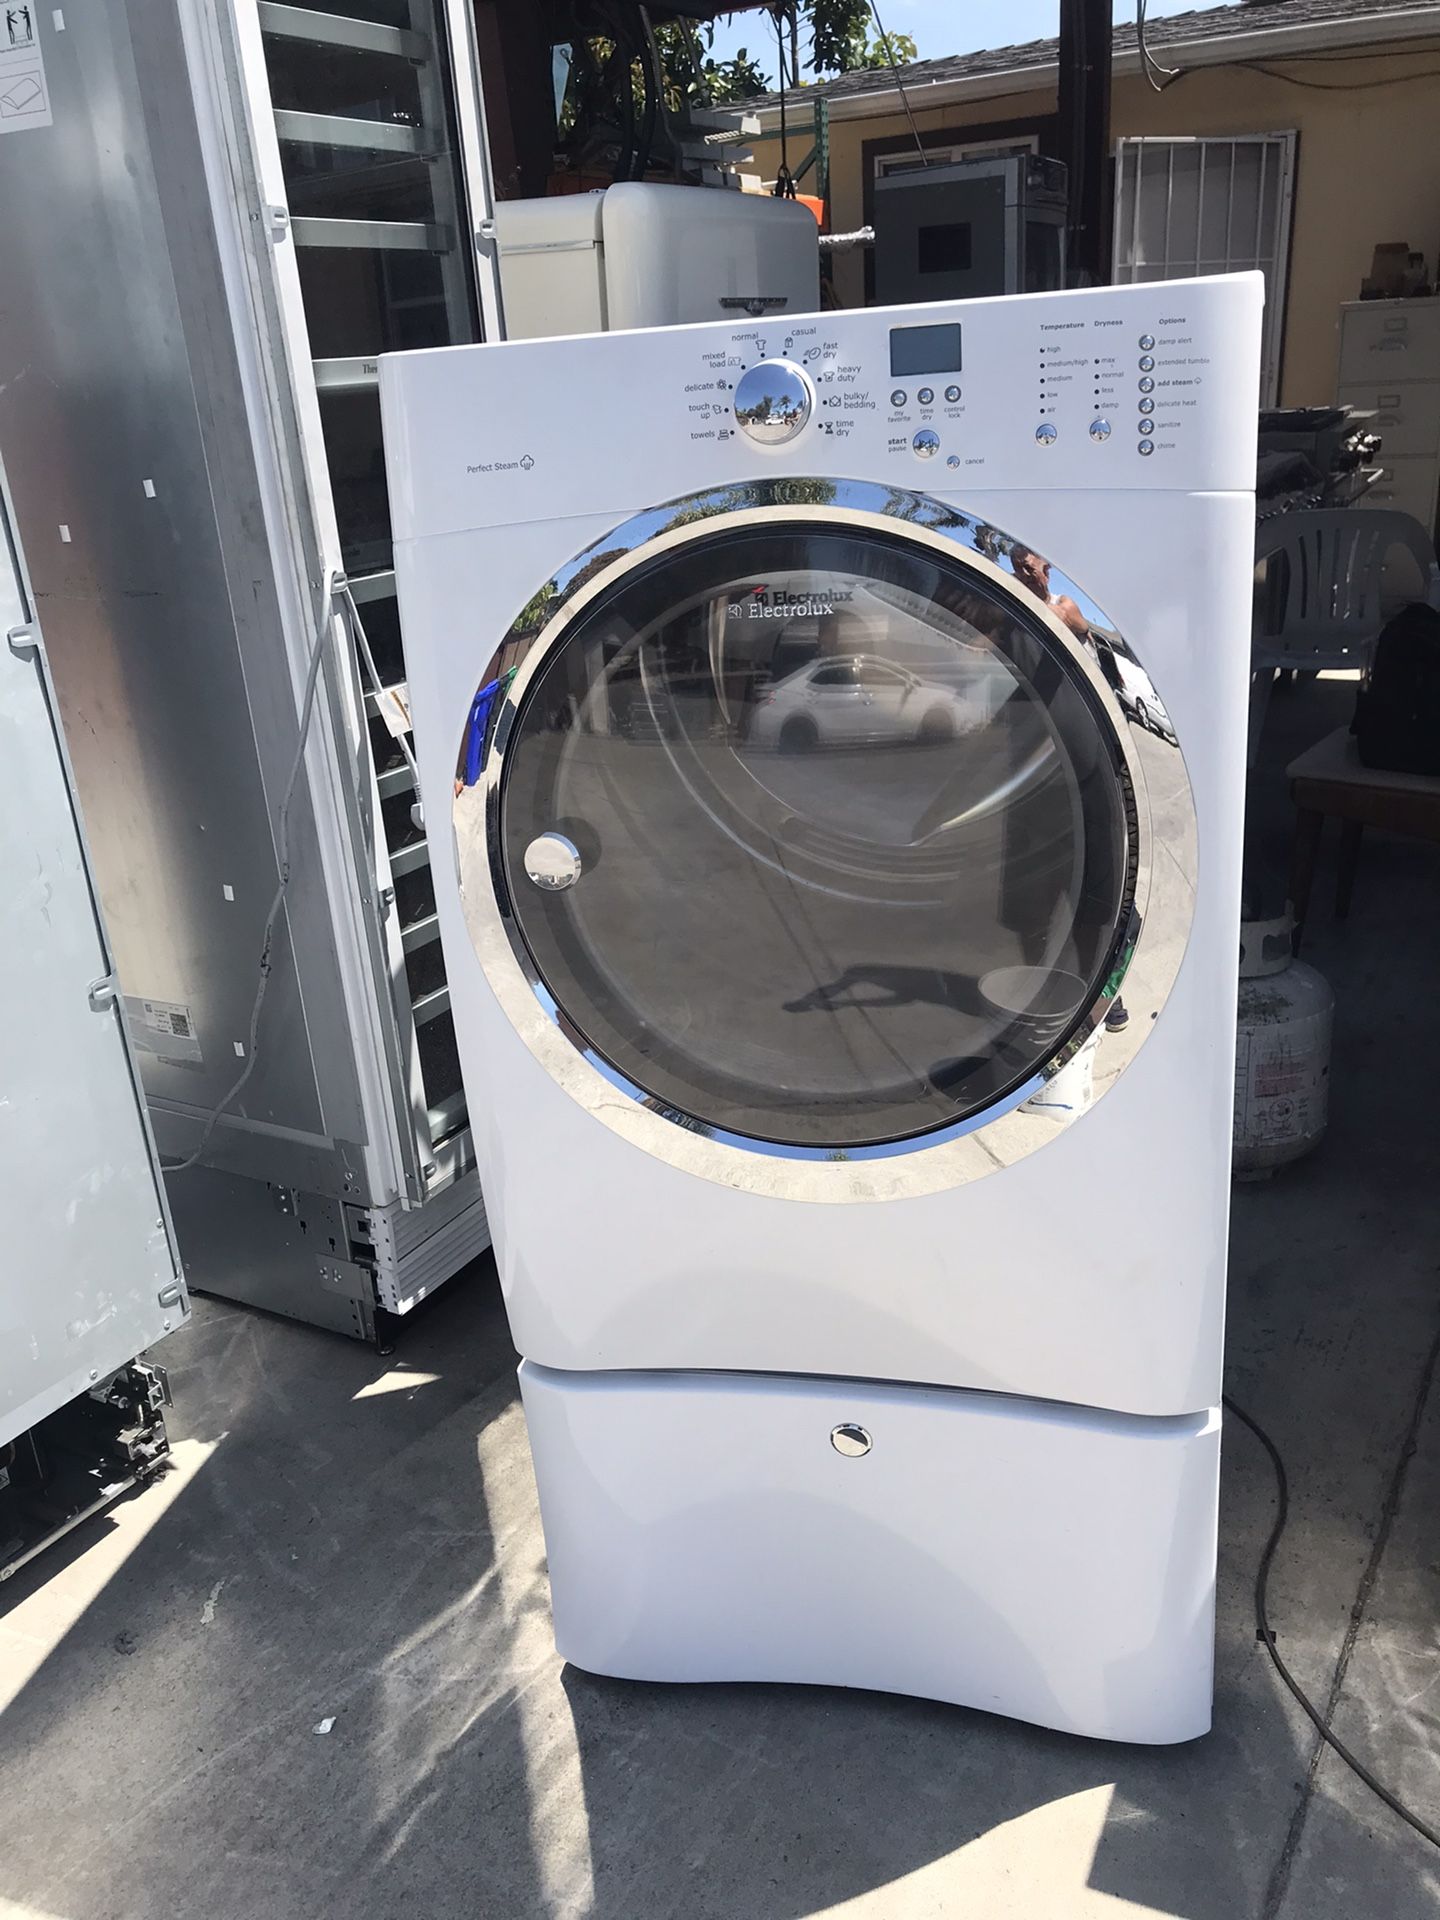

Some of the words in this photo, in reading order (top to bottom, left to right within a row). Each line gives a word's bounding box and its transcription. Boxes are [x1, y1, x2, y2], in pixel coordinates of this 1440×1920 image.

[1094, 319, 1123, 328] Dryness
[1158, 317, 1186, 325] Options
[1040, 322, 1085, 331] Temperature
[791, 327, 817, 337] casual
[731, 332, 759, 342] normal
[823, 342, 839, 350] fast
[1157, 338, 1176, 346] damp
[702, 352, 726, 360] mixed
[823, 350, 837, 359] dry
[709, 359, 726, 369] load
[1047, 359, 1088, 368] medium/high
[1157, 358, 1187, 366] extended
[837, 365, 862, 374] heavy
[837, 373, 856, 382] duty
[684, 382, 714, 392] delicate
[1157, 379, 1170, 387] add
[843, 391, 870, 401] bulky/
[688, 402, 710, 412] touch
[844, 400, 876, 410] bedding
[1157, 400, 1181, 408] delicate
[700, 411, 711, 420] up
[836, 420, 855, 428] time
[1157, 421, 1181, 429] sanitize
[690, 430, 715, 440] towels
[836, 427, 850, 437] dry
[965, 457, 985, 465] cancel
[467, 464, 493, 473] Perfect
[494, 462, 518, 471] Steam
[748, 601, 834, 619] Electrolux
